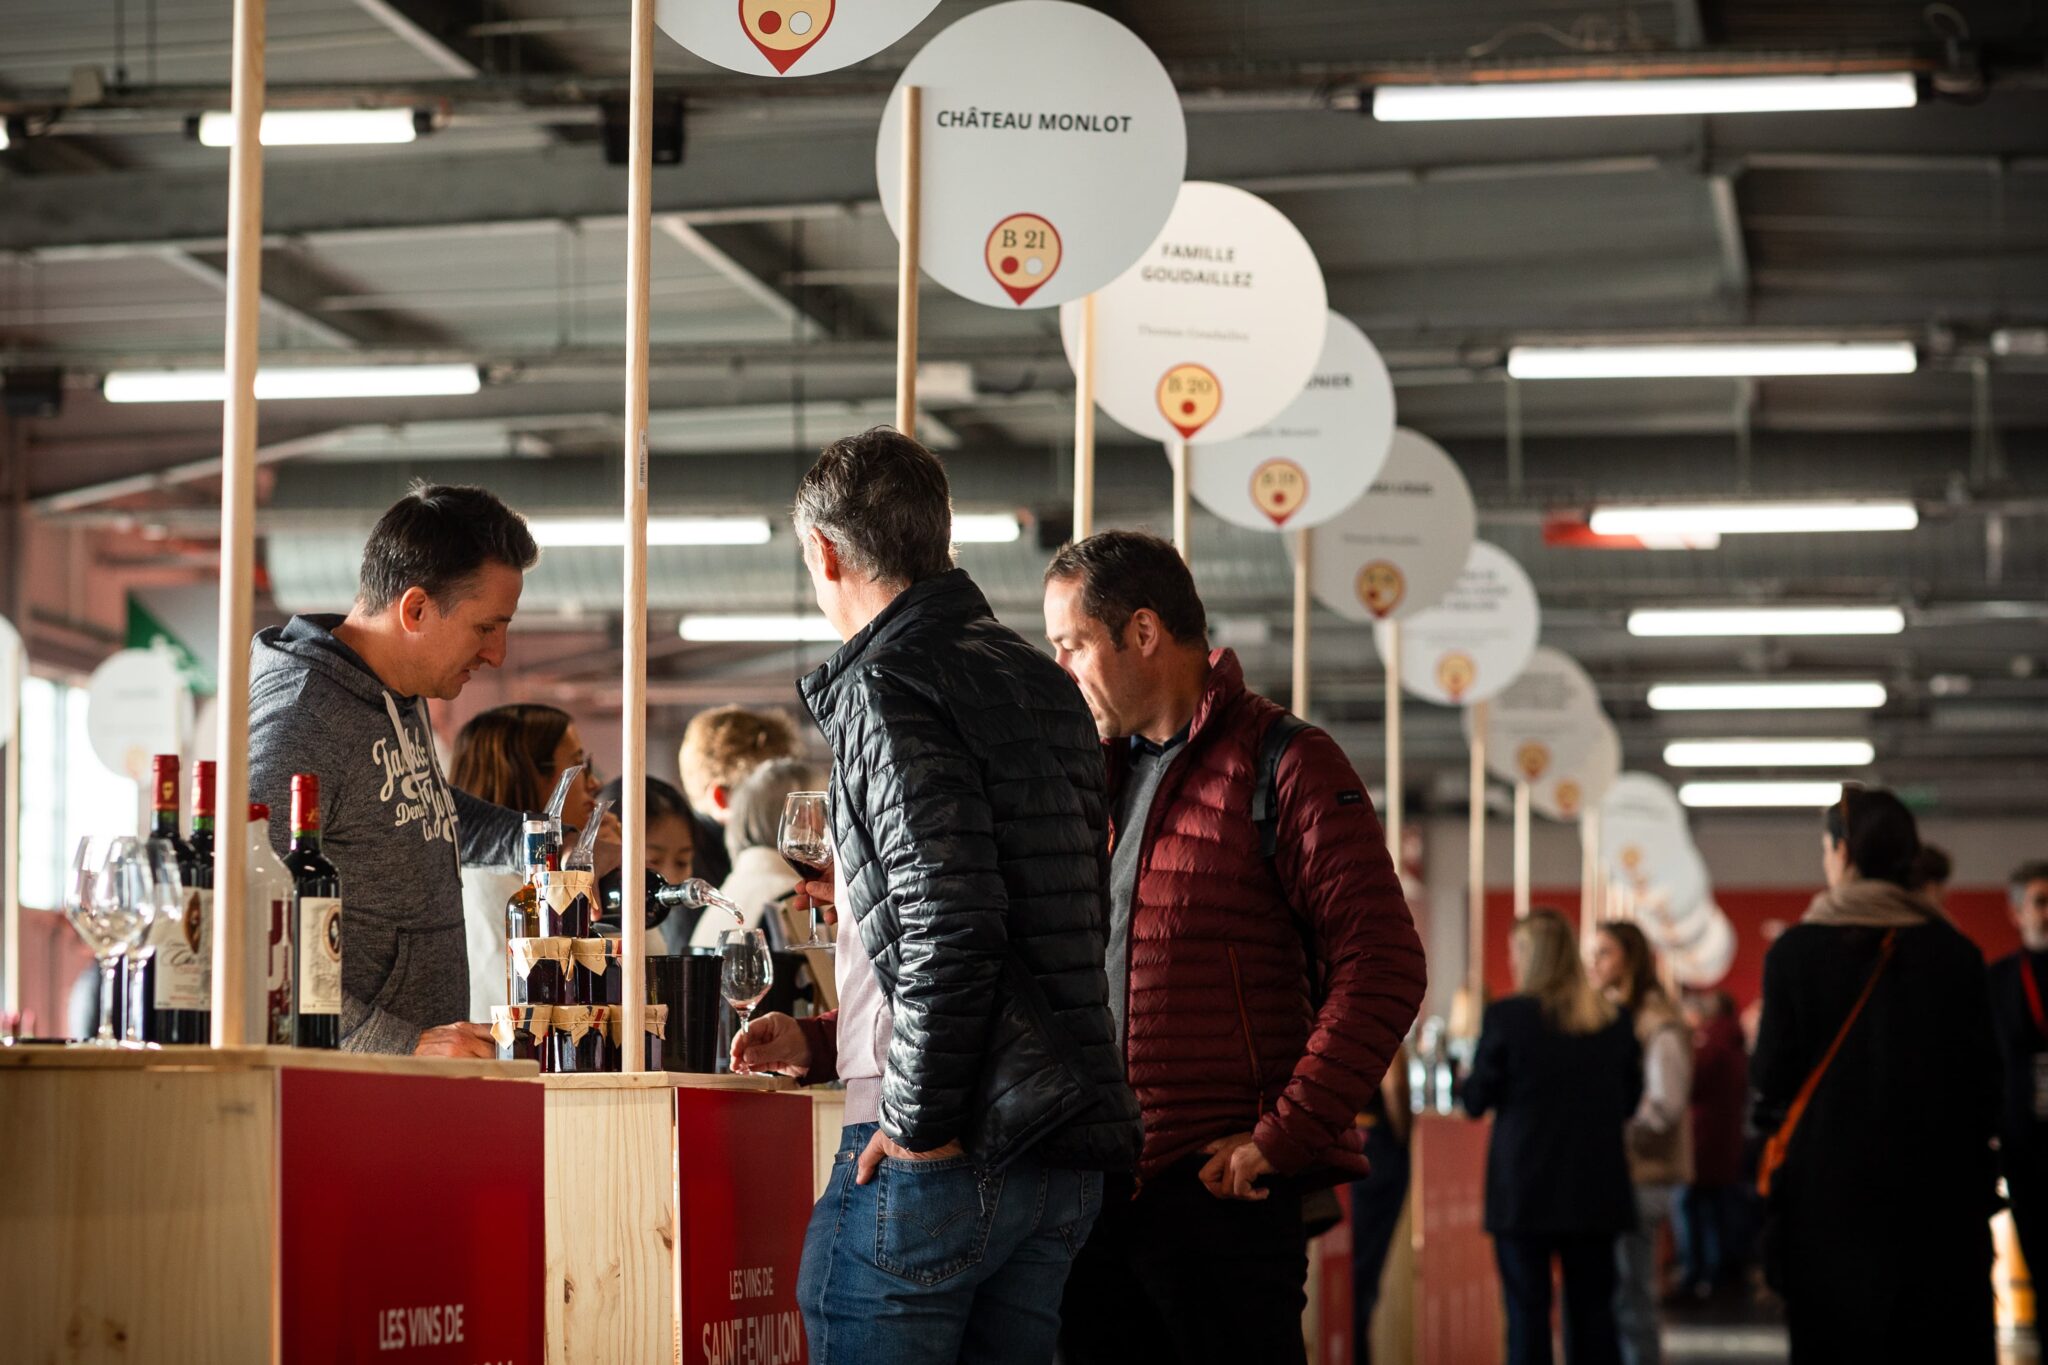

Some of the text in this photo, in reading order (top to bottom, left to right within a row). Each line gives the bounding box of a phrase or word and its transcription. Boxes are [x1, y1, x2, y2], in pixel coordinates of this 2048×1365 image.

[937, 107, 1132, 133] CHÂTEAU MONLOT
[1002, 229, 1046, 249] B 21
[1161, 243, 1236, 263] FAMILLE
[1141, 266, 1253, 288] GOUDAILLEZ
[729, 1267, 774, 1301] LES VINS DE
[379, 1304, 465, 1351] LES VINS DE
[702, 1310, 801, 1365] SAINT-EMILION
